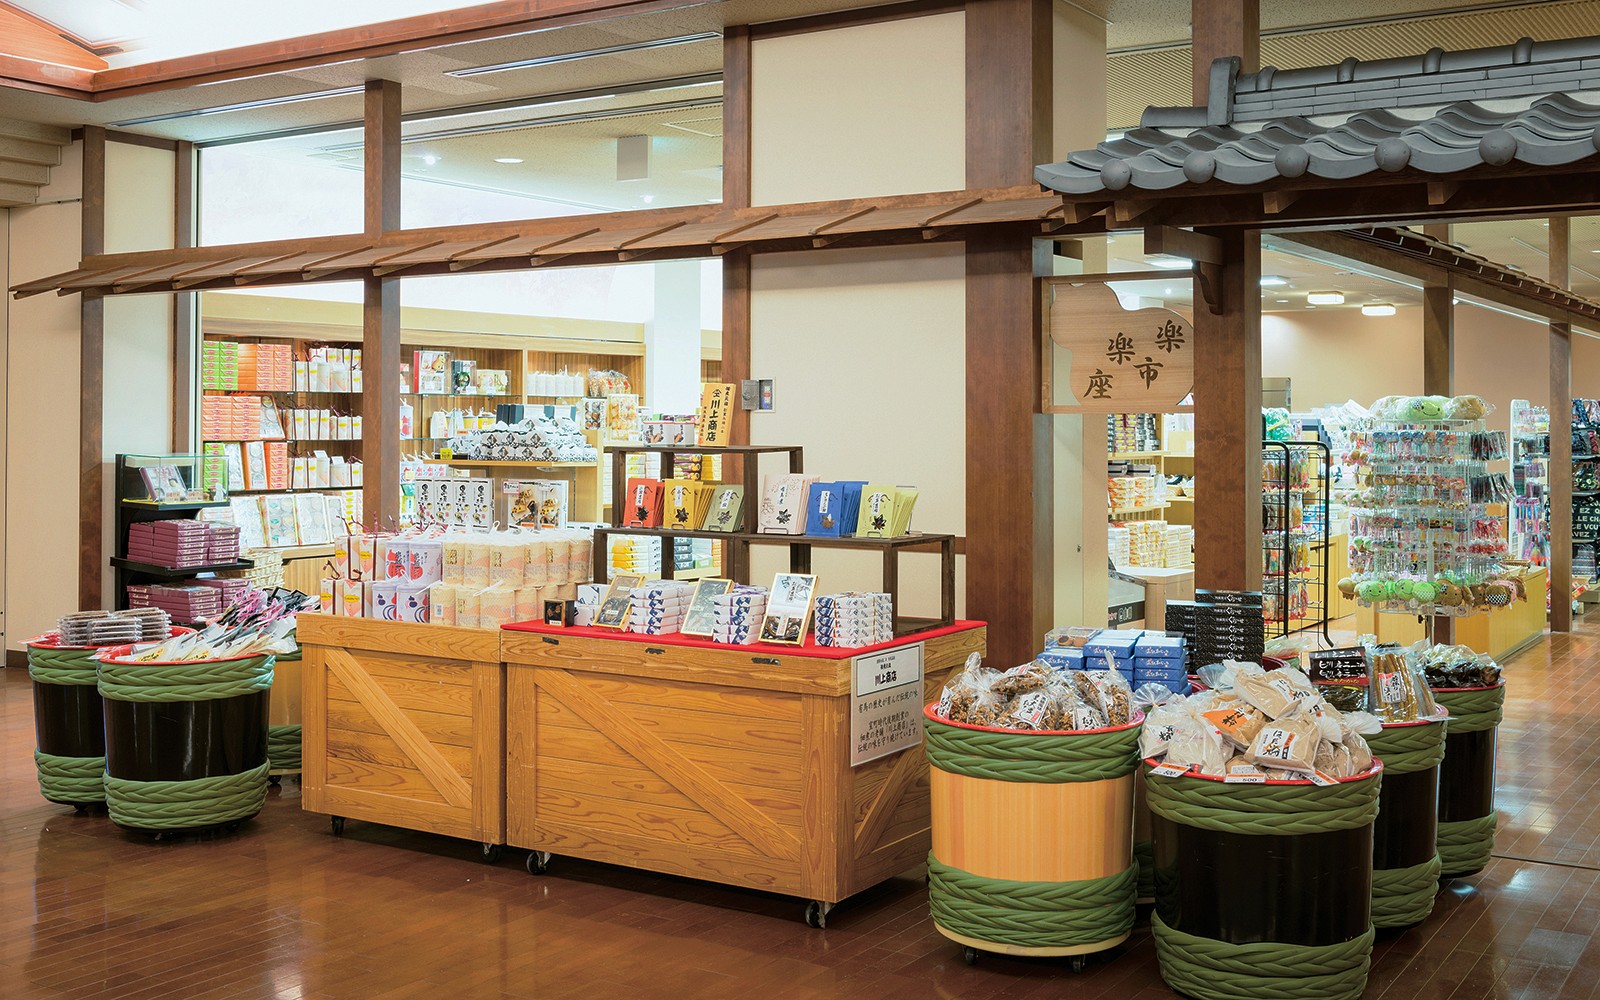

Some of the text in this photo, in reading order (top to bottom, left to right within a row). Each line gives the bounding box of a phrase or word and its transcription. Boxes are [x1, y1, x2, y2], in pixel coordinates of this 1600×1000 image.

[705, 399, 721, 442] 川上商店
[874, 670, 897, 686] 川上商店
